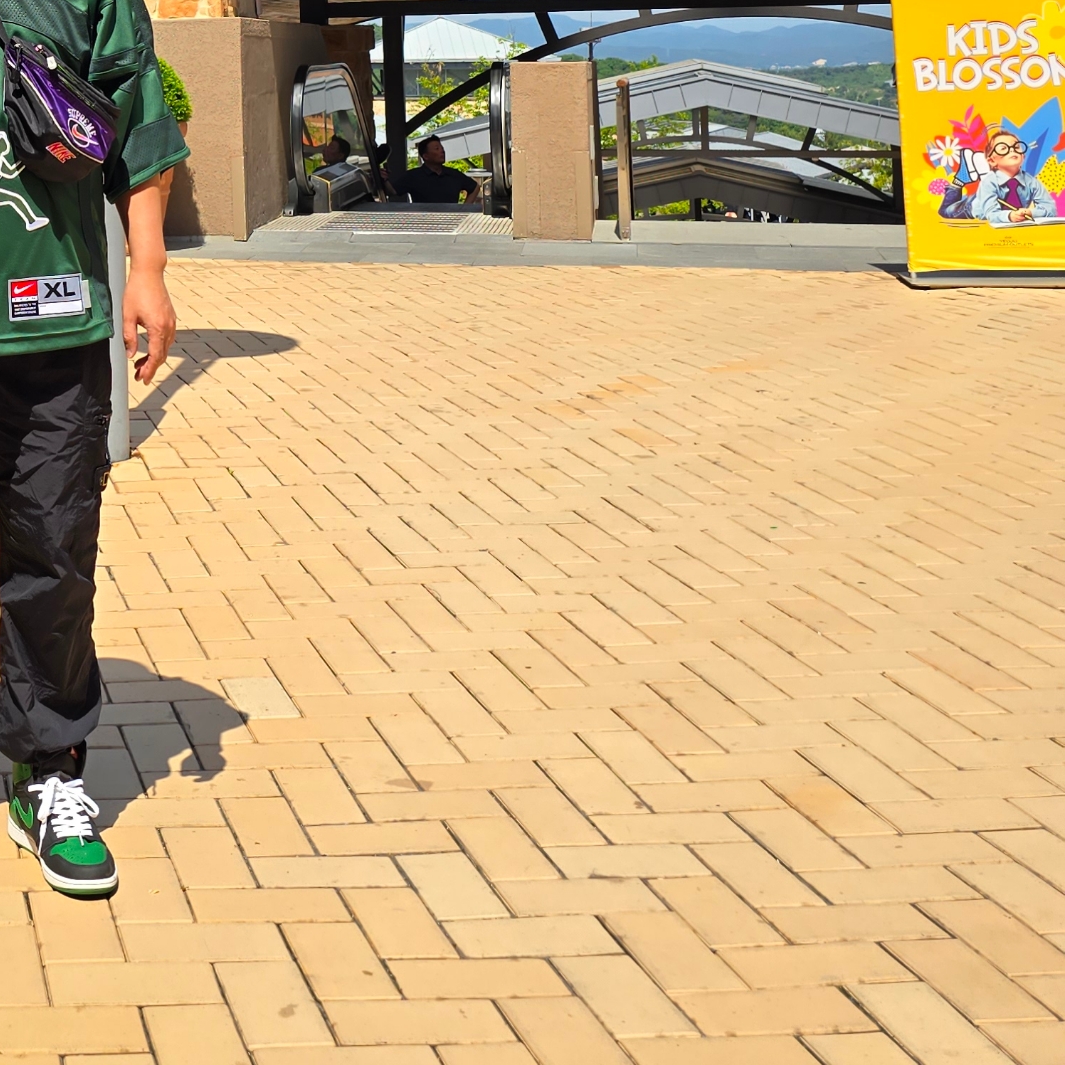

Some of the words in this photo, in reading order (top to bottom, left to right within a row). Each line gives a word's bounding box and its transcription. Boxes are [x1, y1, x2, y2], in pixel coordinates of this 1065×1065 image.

[946, 18, 1039, 58] KIDS
[67, 108, 97, 138] SUPREME
[46, 142, 77, 163] NIKE
[43, 281, 76, 299] XL
